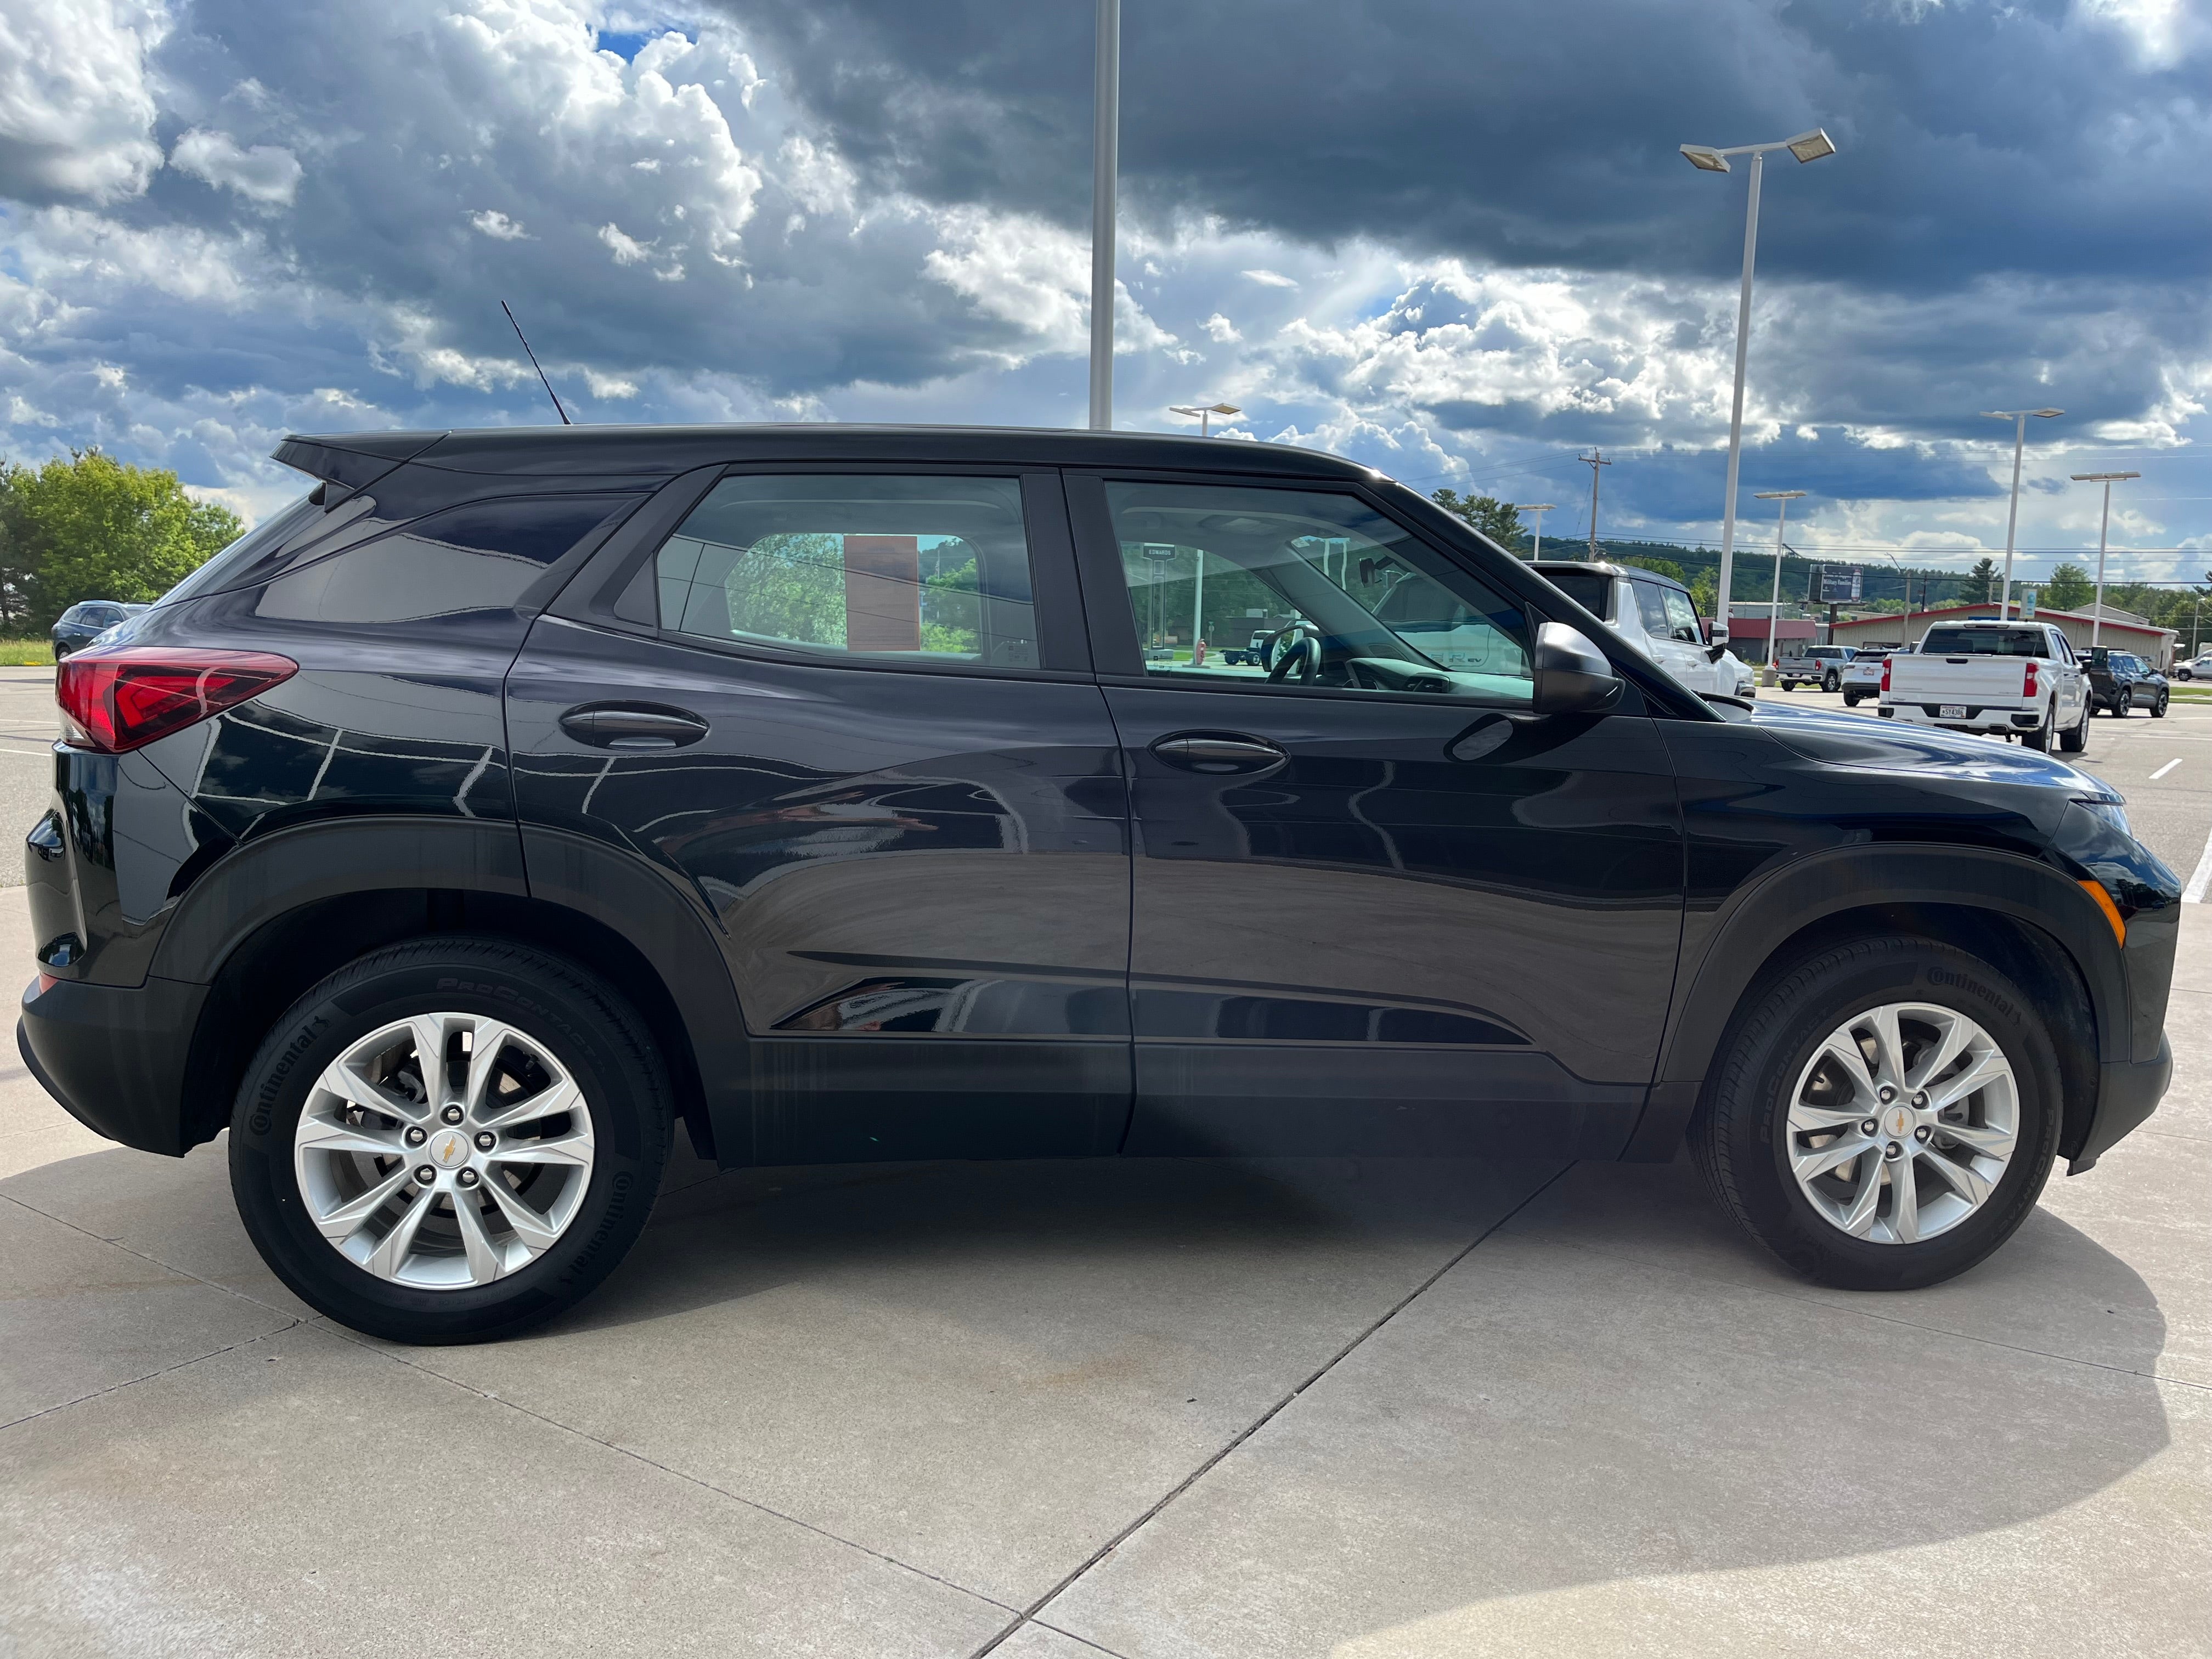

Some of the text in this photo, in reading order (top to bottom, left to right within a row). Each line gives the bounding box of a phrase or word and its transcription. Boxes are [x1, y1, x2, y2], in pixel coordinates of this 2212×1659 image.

[1927, 966, 2013, 1017] Continental
[249, 1025, 318, 1136] Continental
[568, 1171, 634, 1276] Continental
